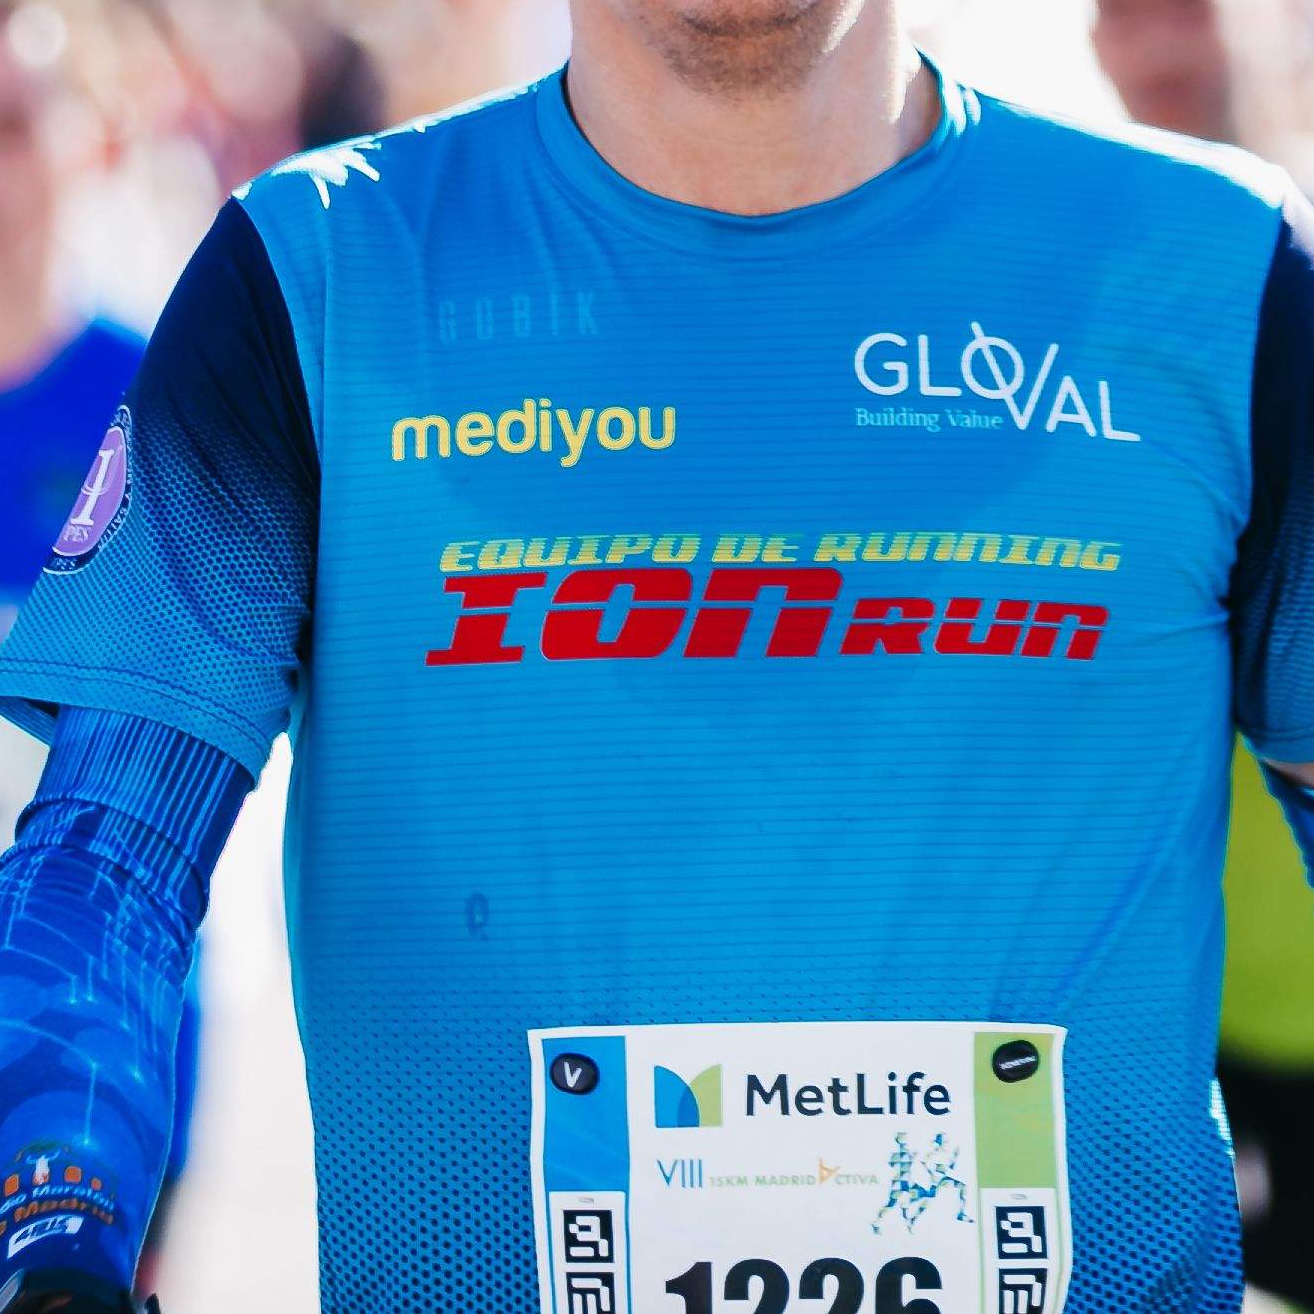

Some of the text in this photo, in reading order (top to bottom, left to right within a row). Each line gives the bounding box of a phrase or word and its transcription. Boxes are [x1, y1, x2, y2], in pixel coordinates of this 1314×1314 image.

[439, 289, 599, 344] GOBIK
[391, 398, 677, 467] mediyou
[855, 407, 1004, 432] Building Value
[439, 532, 1122, 572] EQUIPO DE RUNNING
[745, 1071, 951, 1117] MetLife
[656, 1159, 703, 1188] VIII
[754, 1173, 816, 1187] MADRID
